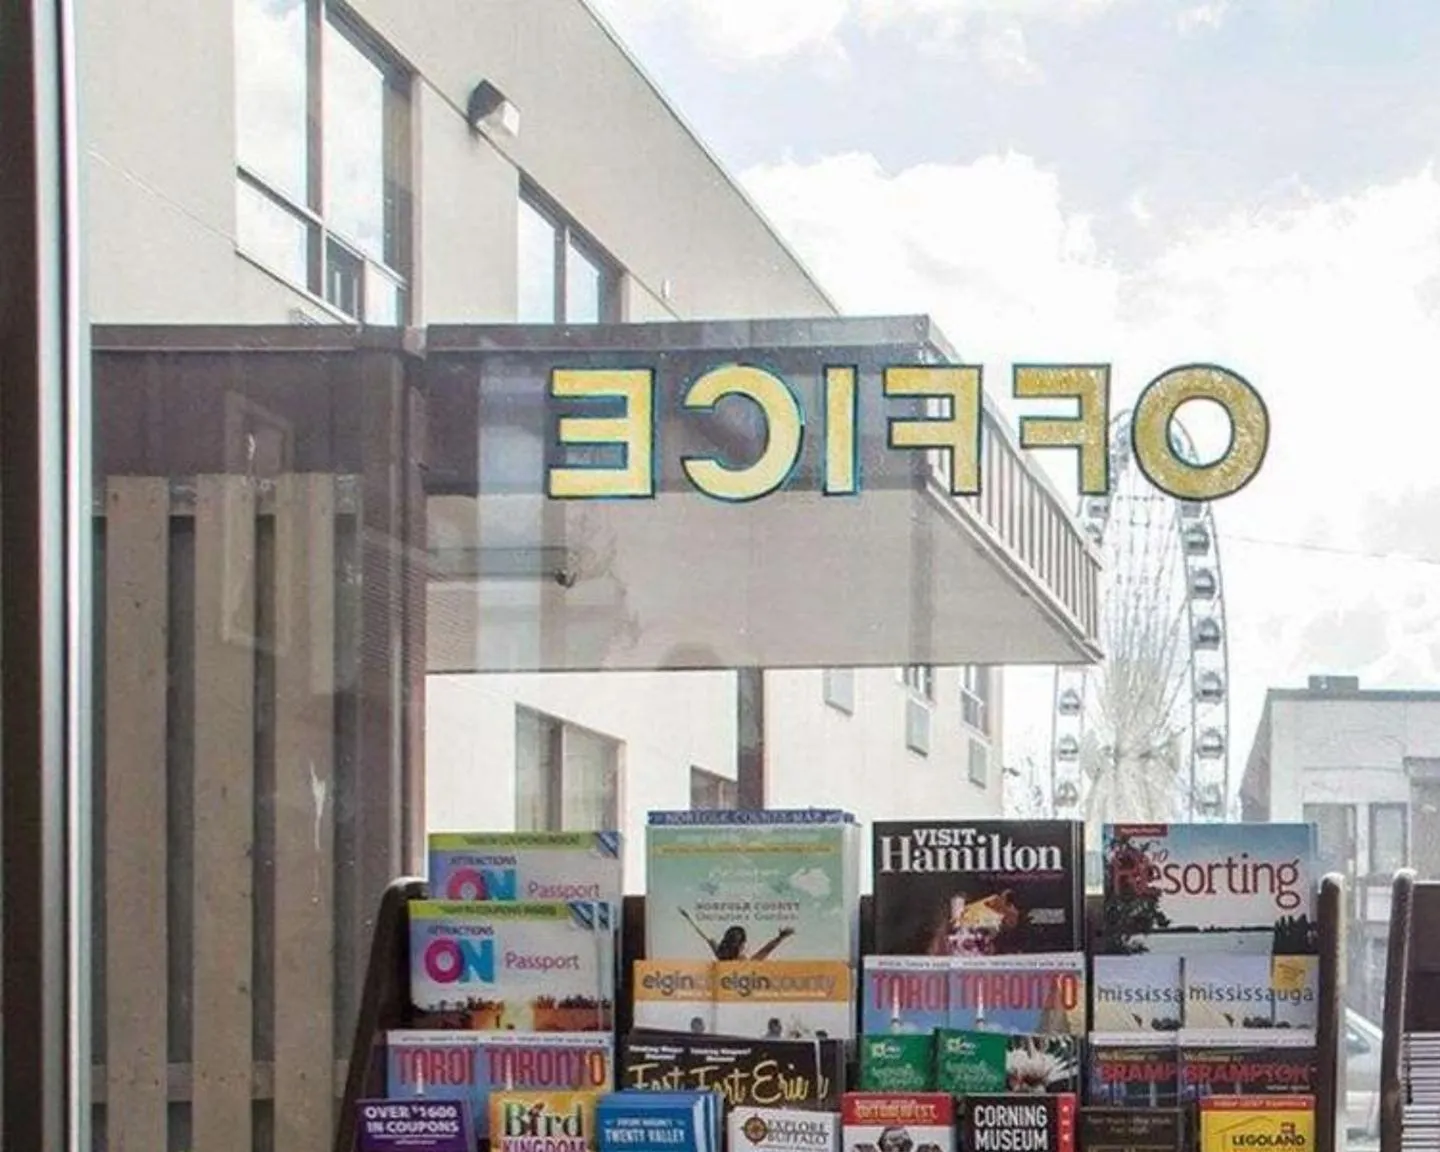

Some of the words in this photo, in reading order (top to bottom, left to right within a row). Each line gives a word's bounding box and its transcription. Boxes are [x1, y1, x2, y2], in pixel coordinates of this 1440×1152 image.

[914, 829, 976, 846] VISIT
[880, 834, 1064, 873] Hamilton
[529, 879, 600, 900] Passport
[424, 937, 494, 984] ON
[504, 951, 580, 977] Passport
[958, 972, 1079, 1012] TORONTO
[485, 1048, 607, 1088] TORONTO
[1184, 1063, 1310, 1084] BRAMPTON
[752, 1059, 810, 1104] Erie
[364, 1105, 411, 1119] OVER
[505, 1102, 583, 1138] Bird
[974, 1105, 1048, 1128] CORNING
[366, 1122, 384, 1134] IN
[386, 1121, 459, 1134] COUPONS
[974, 1129, 1049, 1152] MUSEUM
[1232, 1134, 1306, 1147] LEGOLAND
